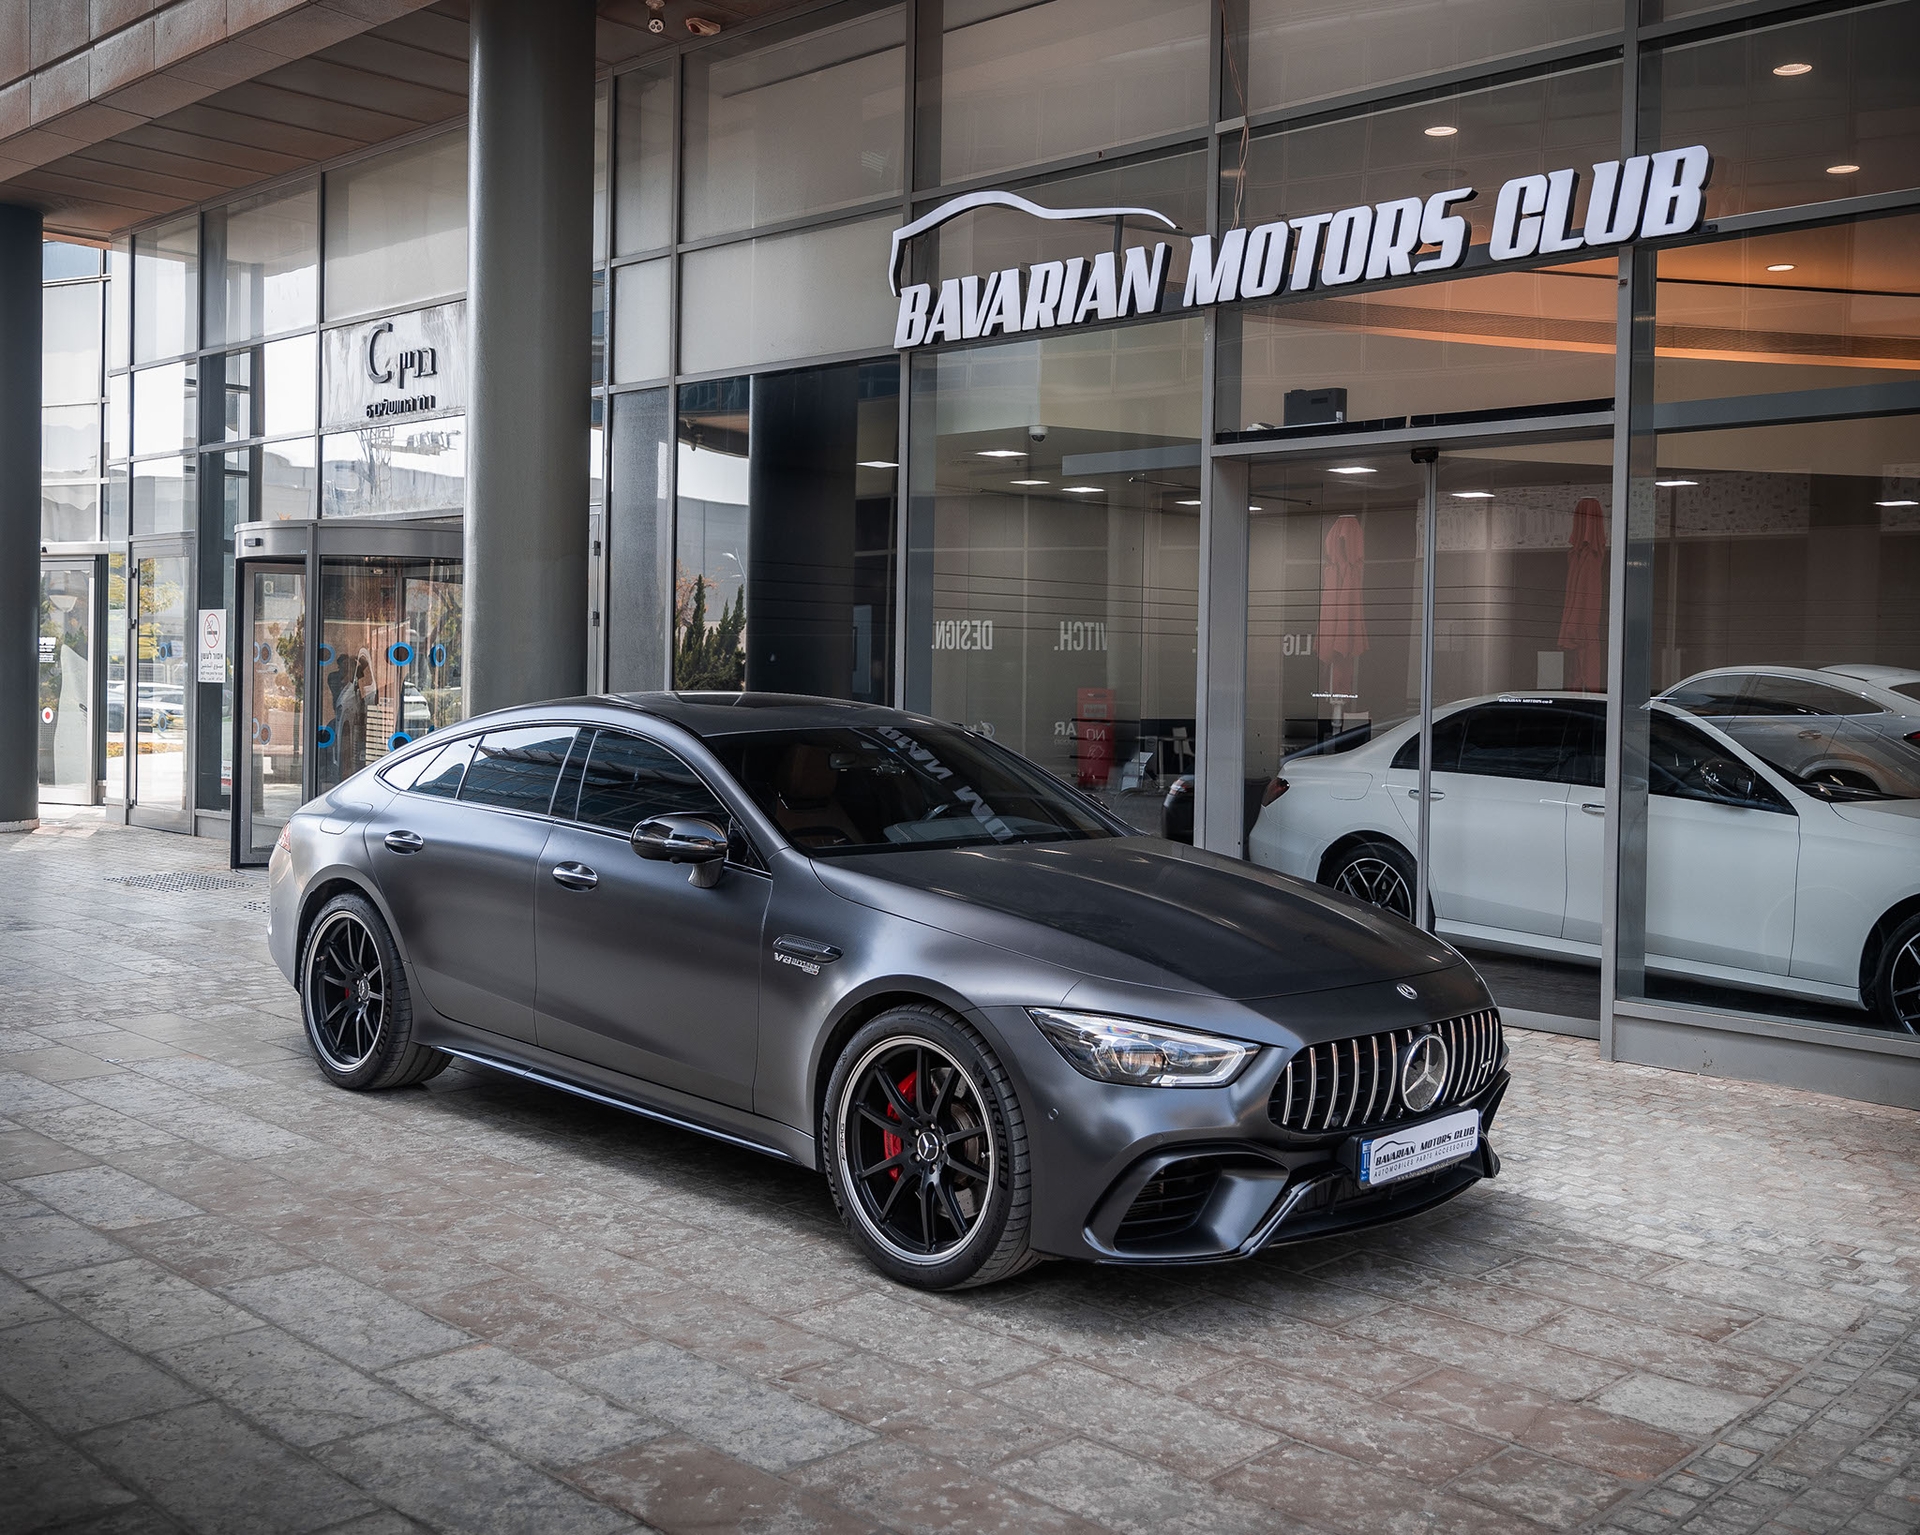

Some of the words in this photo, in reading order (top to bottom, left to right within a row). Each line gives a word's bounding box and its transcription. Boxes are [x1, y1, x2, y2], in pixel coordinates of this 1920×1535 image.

[893, 243, 1173, 350] BAVARIAN
[1183, 187, 1480, 307] MOTORS
[1489, 145, 1714, 262] CLUB
[365, 322, 394, 384] C
[985, 1086, 1008, 1185] MICHELIN
[1374, 1158, 1414, 1177] AUTOMOBILES
[1416, 1154, 1433, 1165] PARTS
[1434, 1139, 1474, 1156] ACCESSORIES
[1375, 1145, 1416, 1166] BAVARIAN
[1419, 1132, 1452, 1151] MOTORS
[1453, 1126, 1475, 1140] CLUB
